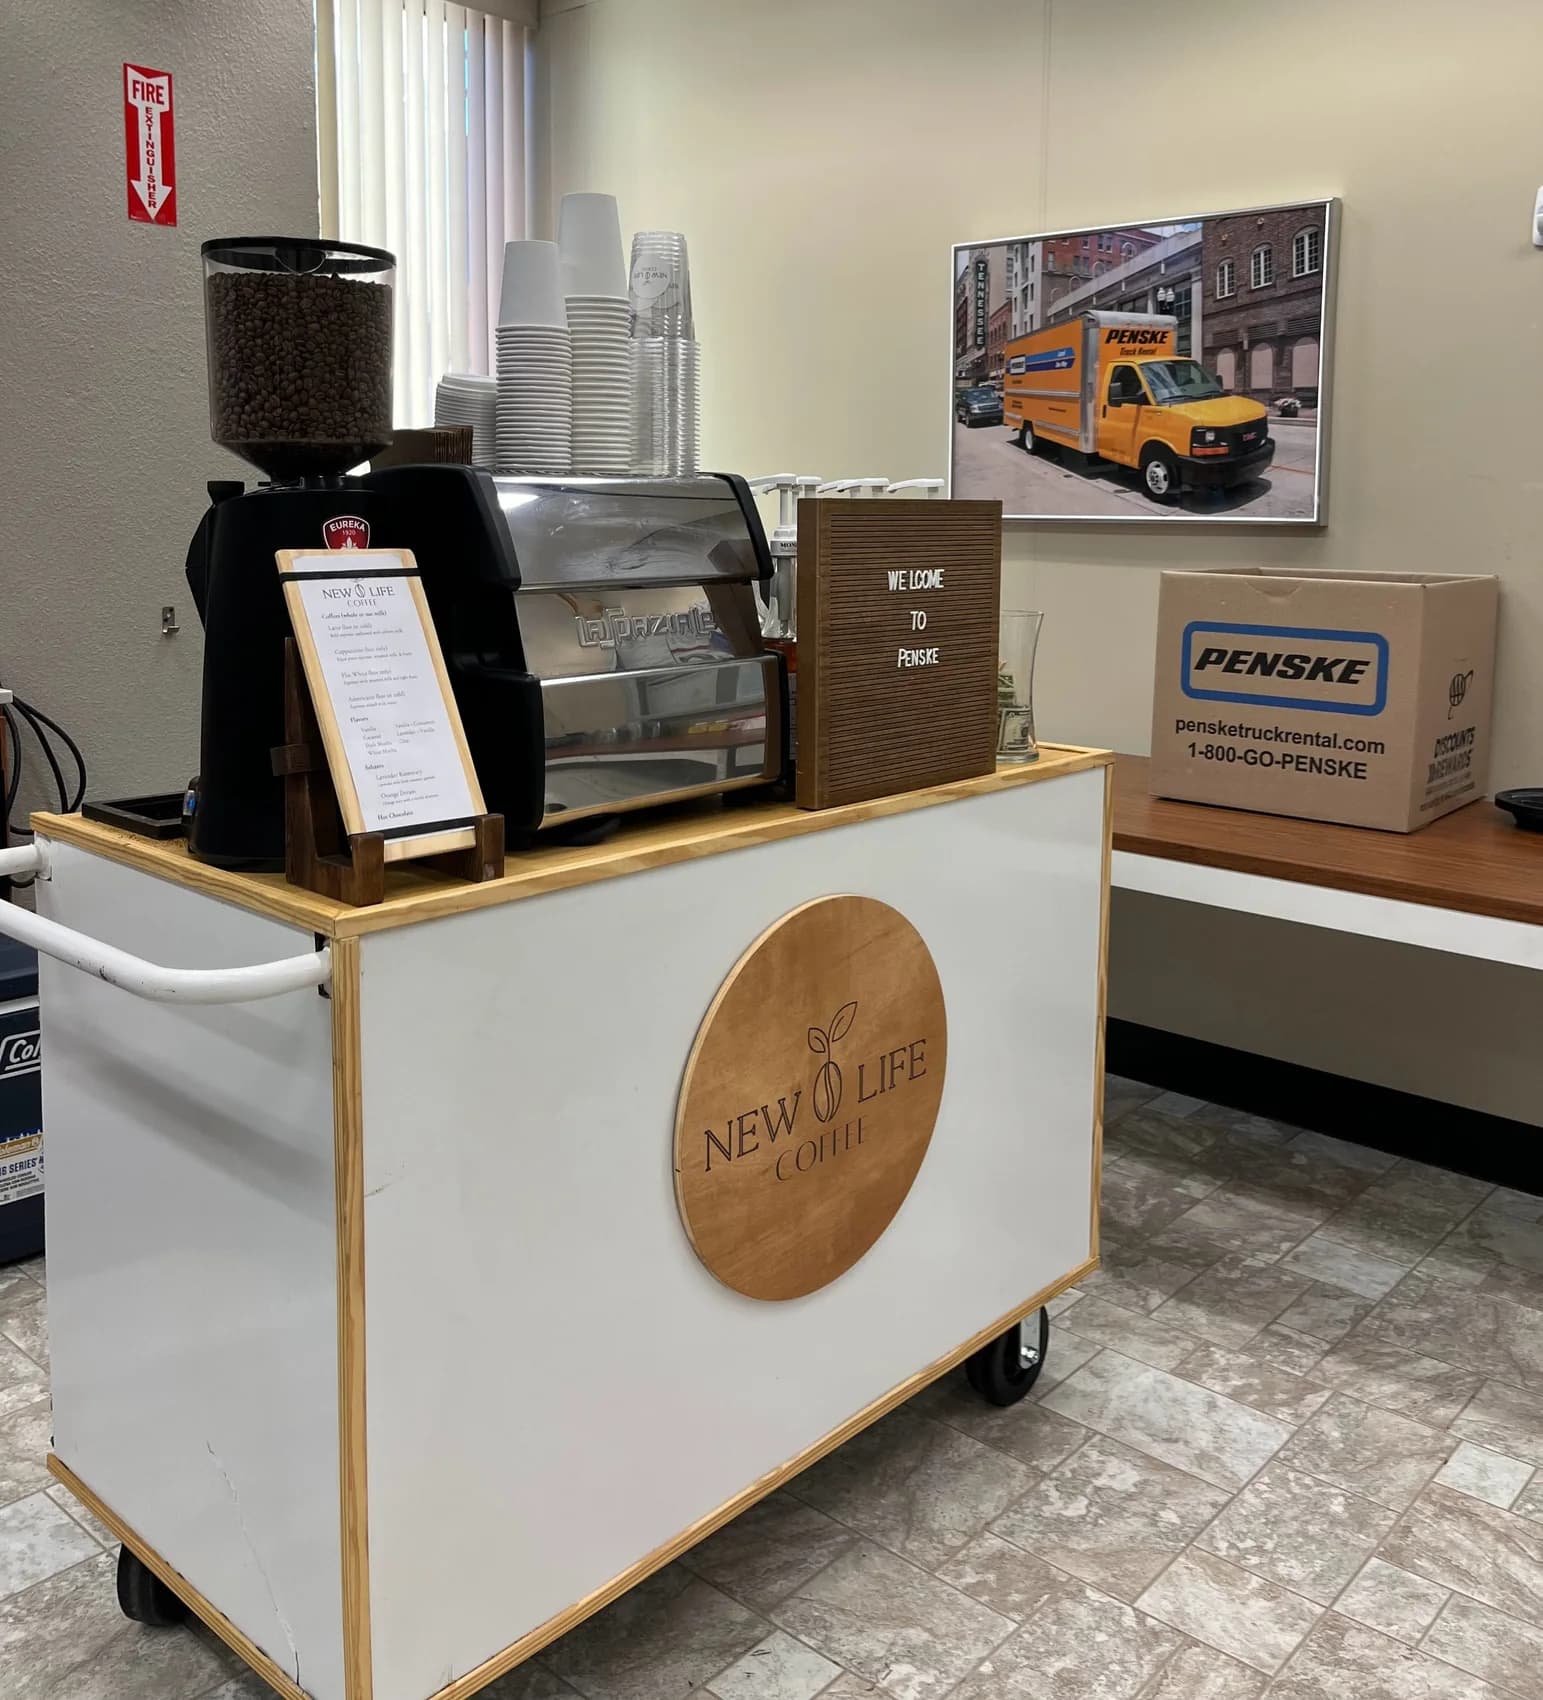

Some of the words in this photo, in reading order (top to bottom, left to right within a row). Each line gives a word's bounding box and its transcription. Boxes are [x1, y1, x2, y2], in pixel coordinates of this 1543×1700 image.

[132, 80, 164, 106] FIRE
[145, 106, 157, 208] EXTINGUISHER
[977, 264, 986, 344] TENNESSEE
[1105, 329, 1169, 344] PENSKE
[330, 520, 365, 532] EUREKA
[888, 569, 944, 590] WELCOME
[322, 588, 352, 599] NEW
[369, 586, 395, 597] LIFE
[910, 611, 926, 630] TO
[898, 648, 940, 668] PENSKE
[1194, 648, 1371, 684] PENSKE
[1176, 719, 1385, 754] pensketruckrental.com
[1189, 742, 1368, 780] 1-800-GO-PENSKE
[704, 1090, 802, 1172] NEW
[858, 1039, 927, 1103] LIFE
[9, 1158, 36, 1174] SERIES
